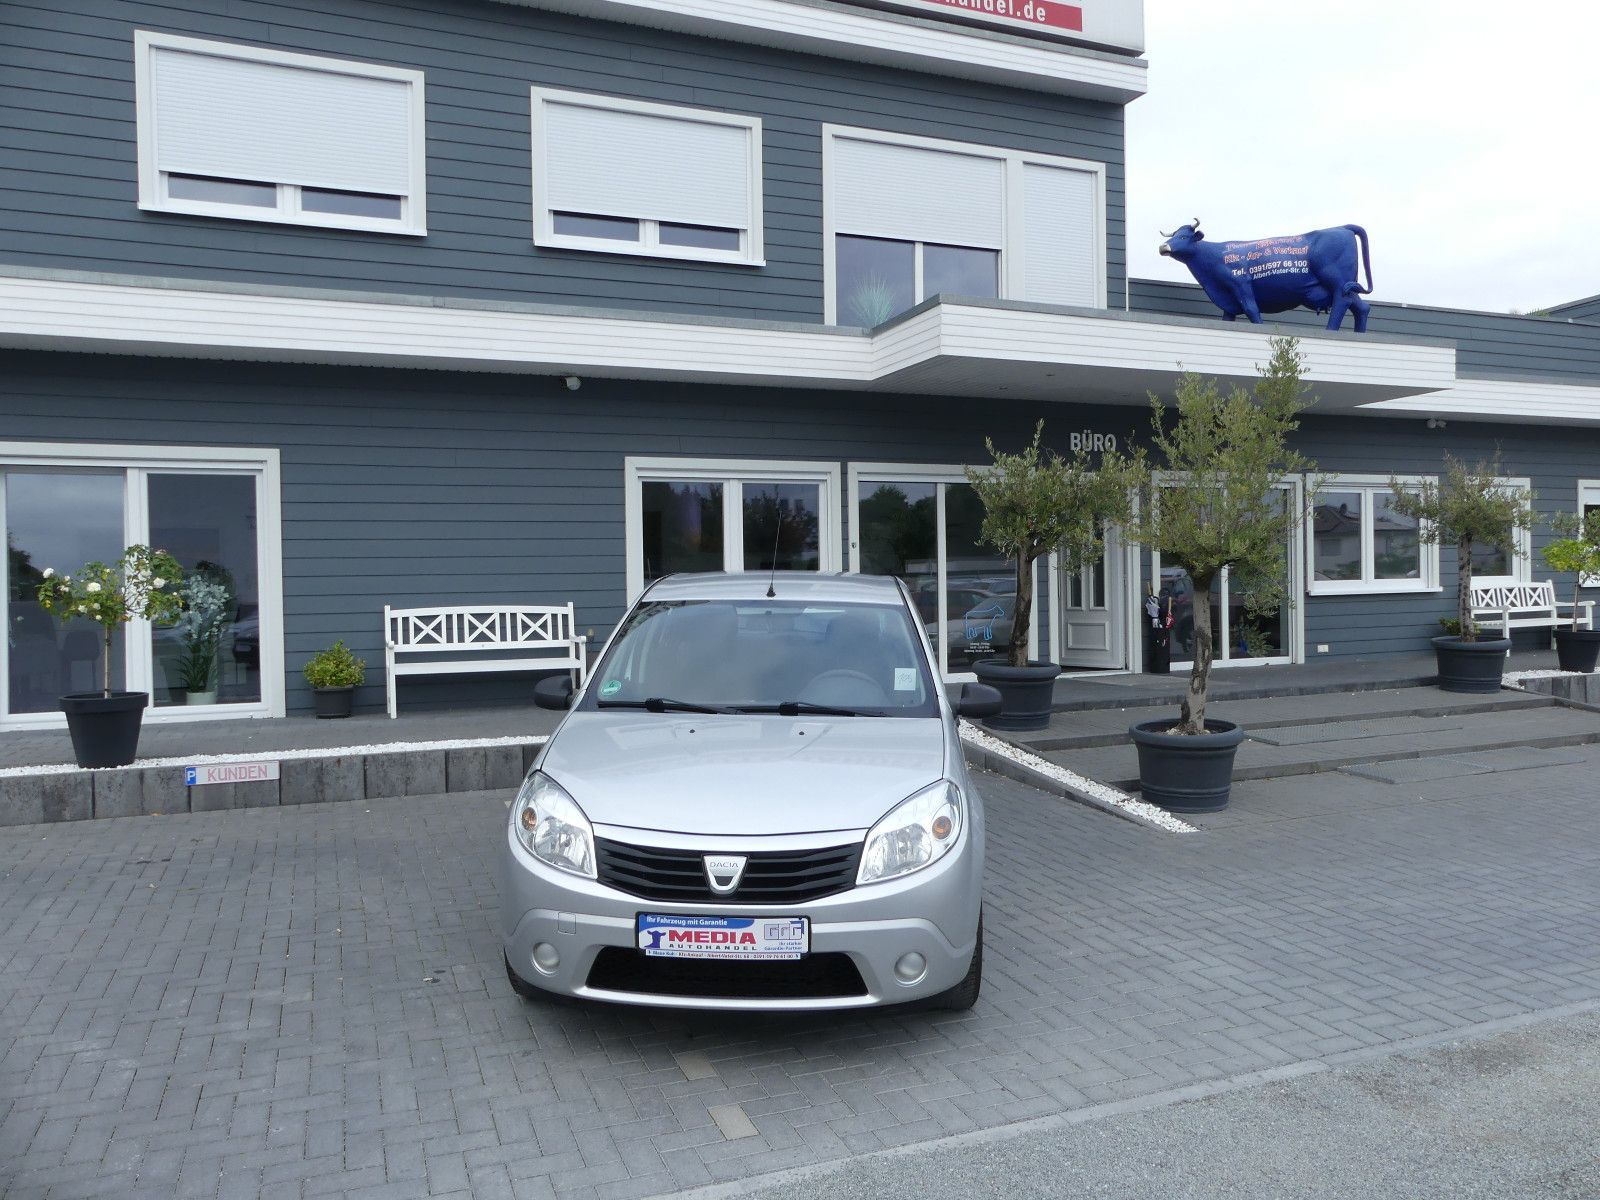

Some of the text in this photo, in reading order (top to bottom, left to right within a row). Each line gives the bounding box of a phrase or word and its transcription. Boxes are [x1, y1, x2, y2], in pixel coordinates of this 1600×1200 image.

[1232, 268, 1247, 276] Tel.
[1293, 260, 1308, 268] 100
[1070, 429, 1117, 452] BÜRO
[187, 765, 268, 782] P KUNDEN
[656, 917, 686, 926] Fahrzeug
[668, 930, 757, 945] MEDIA
[669, 943, 757, 951] AUTOHANDEL
